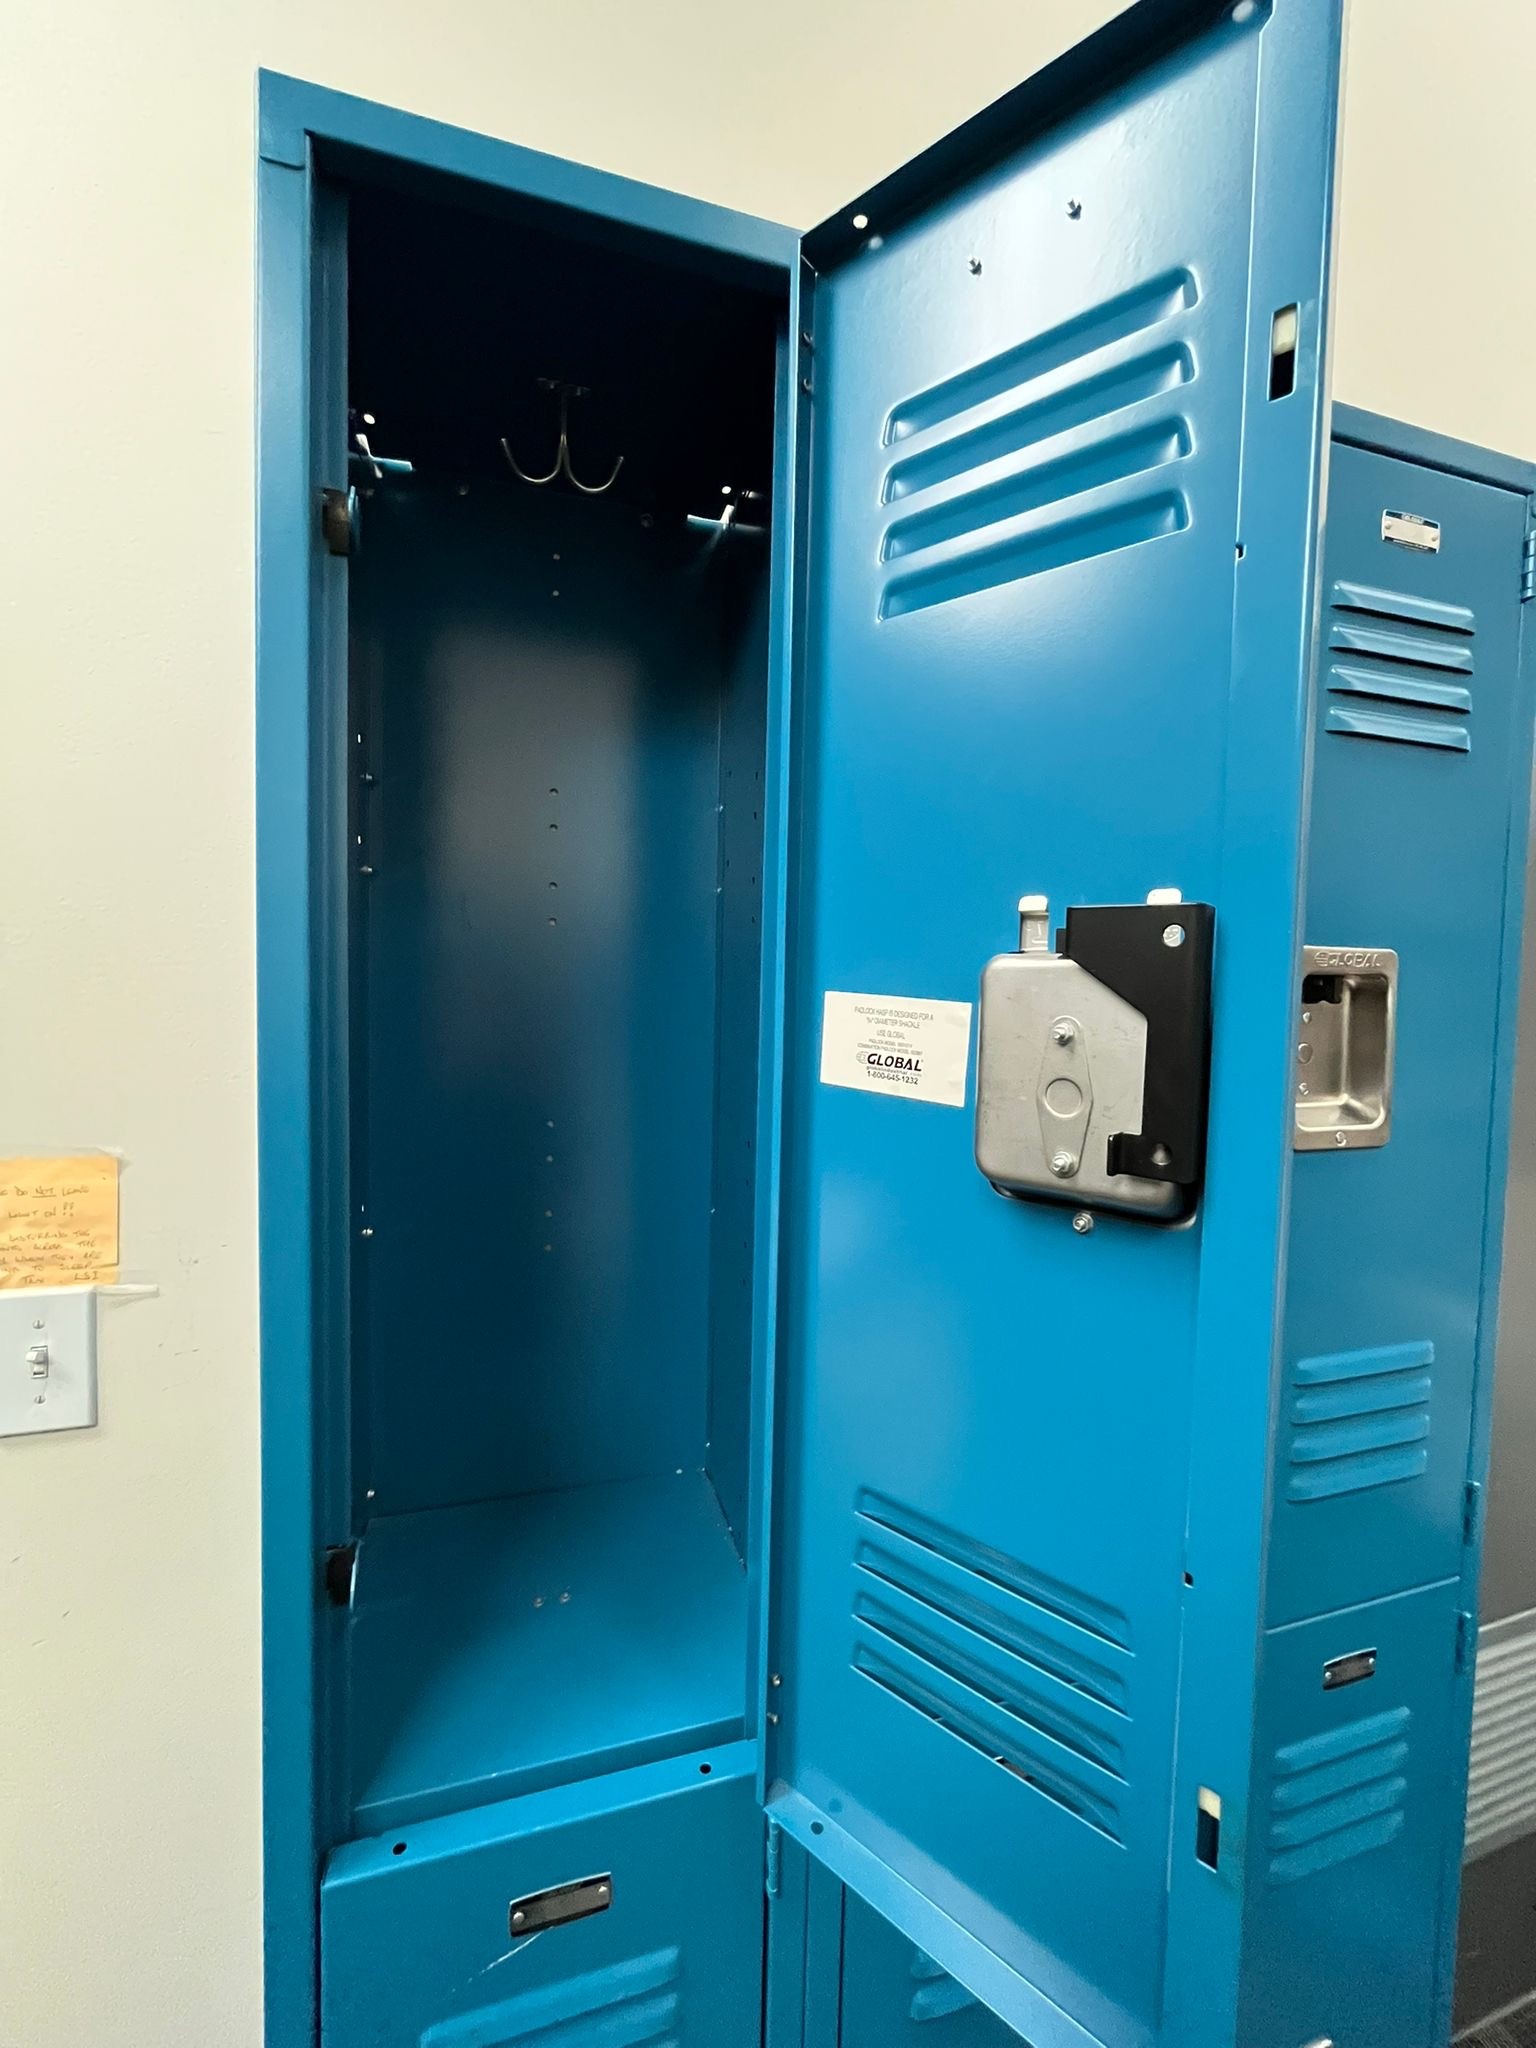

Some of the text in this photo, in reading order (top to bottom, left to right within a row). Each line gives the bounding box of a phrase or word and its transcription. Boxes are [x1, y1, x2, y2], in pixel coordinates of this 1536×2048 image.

[1328, 952, 1381, 968] GLOBAL
[867, 1053, 922, 1072] GLOBAL
[867, 1070, 919, 1085] 1-800-645-1232
